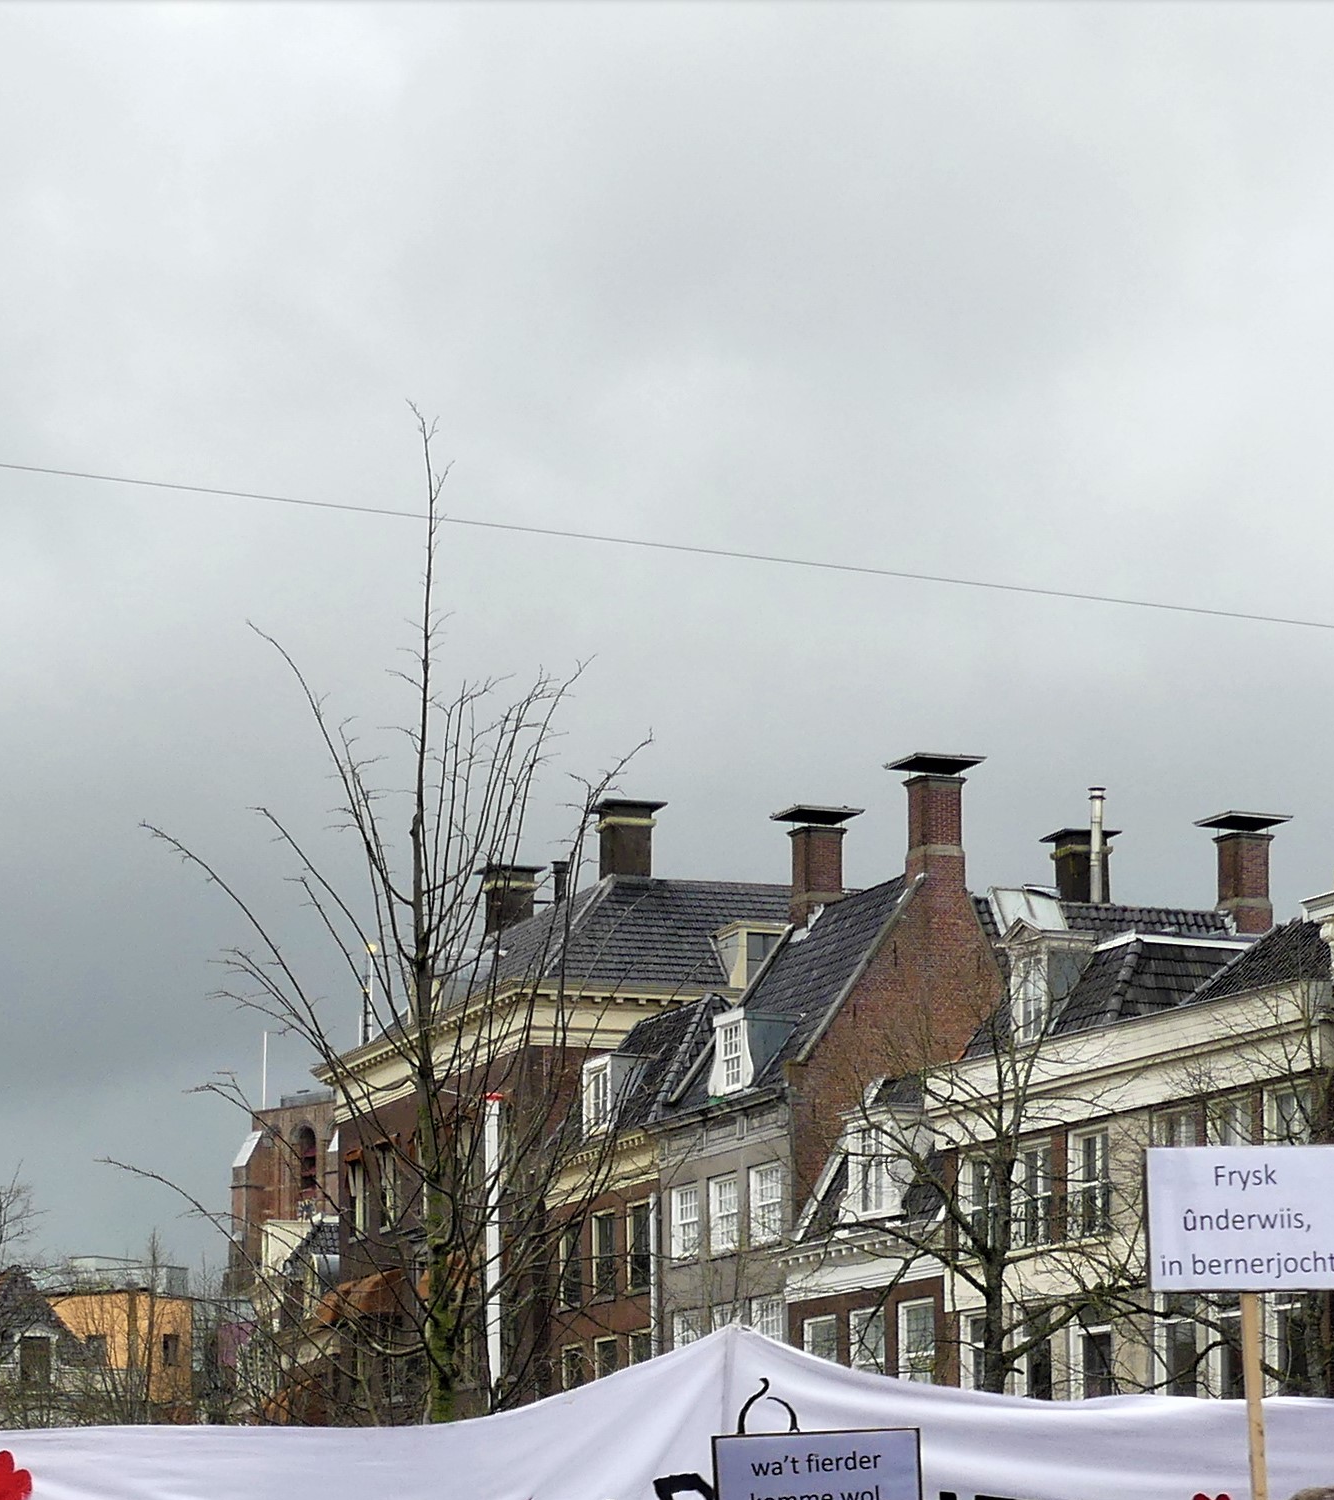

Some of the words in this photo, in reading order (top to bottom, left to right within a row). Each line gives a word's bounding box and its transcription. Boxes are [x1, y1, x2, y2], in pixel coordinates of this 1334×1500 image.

[1214, 1163, 1278, 1191] Frysk
[1182, 1207, 1313, 1233] ûnderwiis,
[1160, 1254, 1183, 1277] in
[806, 1451, 882, 1473] fierder
